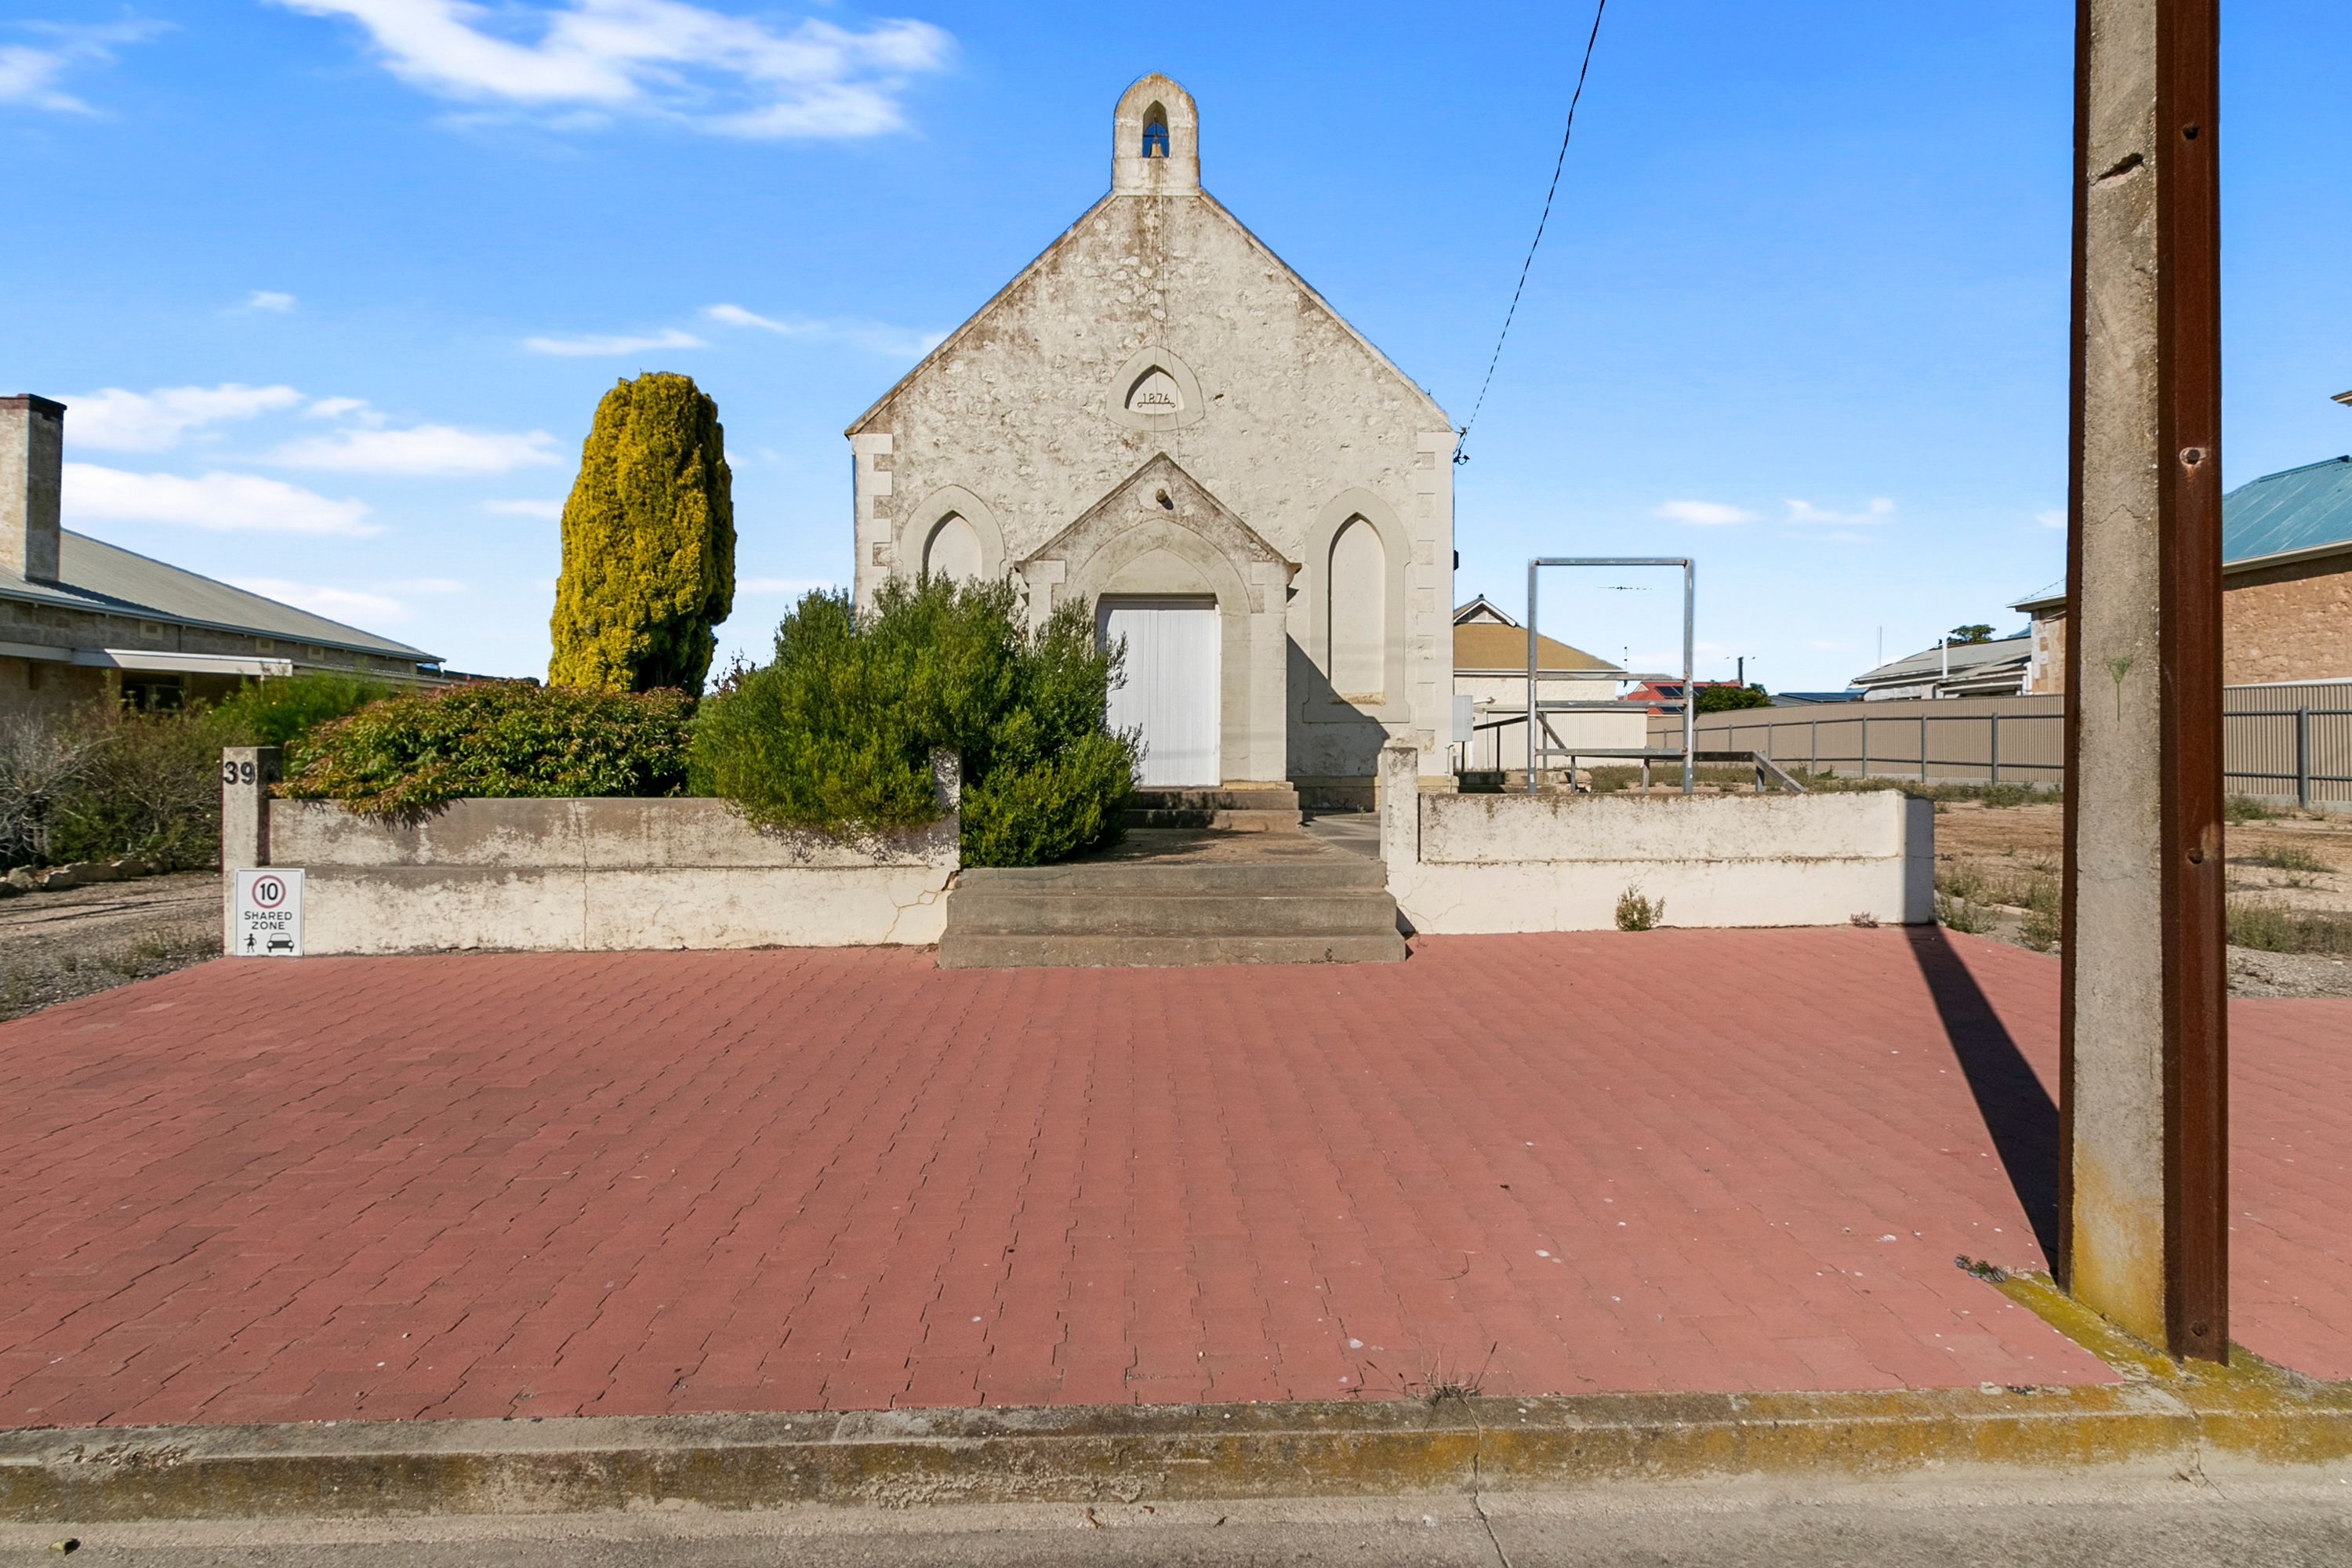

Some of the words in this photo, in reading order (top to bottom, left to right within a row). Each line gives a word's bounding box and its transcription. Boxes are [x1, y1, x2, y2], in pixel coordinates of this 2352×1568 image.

[1142, 393, 1171, 404] 1876
[223, 760, 256, 785] 39
[260, 883, 278, 901] 10
[244, 911, 292, 920] SHARED
[252, 921, 285, 930] ZONE
